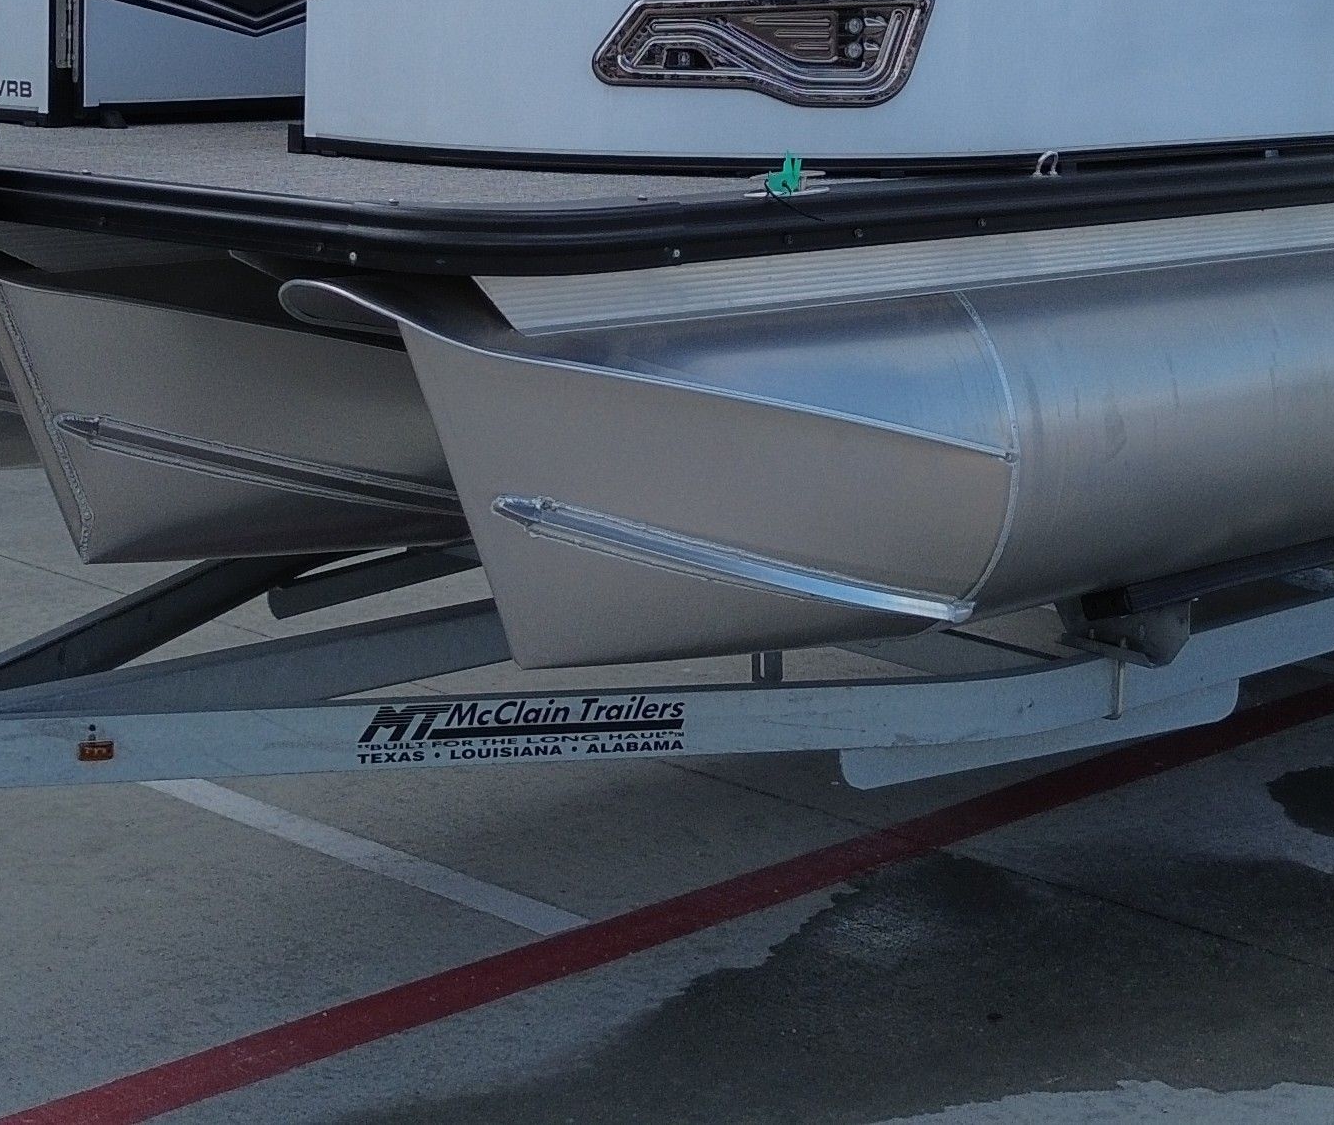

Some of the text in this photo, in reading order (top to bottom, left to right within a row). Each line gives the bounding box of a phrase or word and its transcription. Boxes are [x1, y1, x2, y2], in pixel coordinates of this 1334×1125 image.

[445, 695, 686, 727] McClain Trailers
[357, 739, 685, 764] TEXAS LOUISIANA ALABAMA
[431, 739, 474, 748] FOR
[480, 737, 518, 746] THE
[526, 733, 600, 744] LONG
